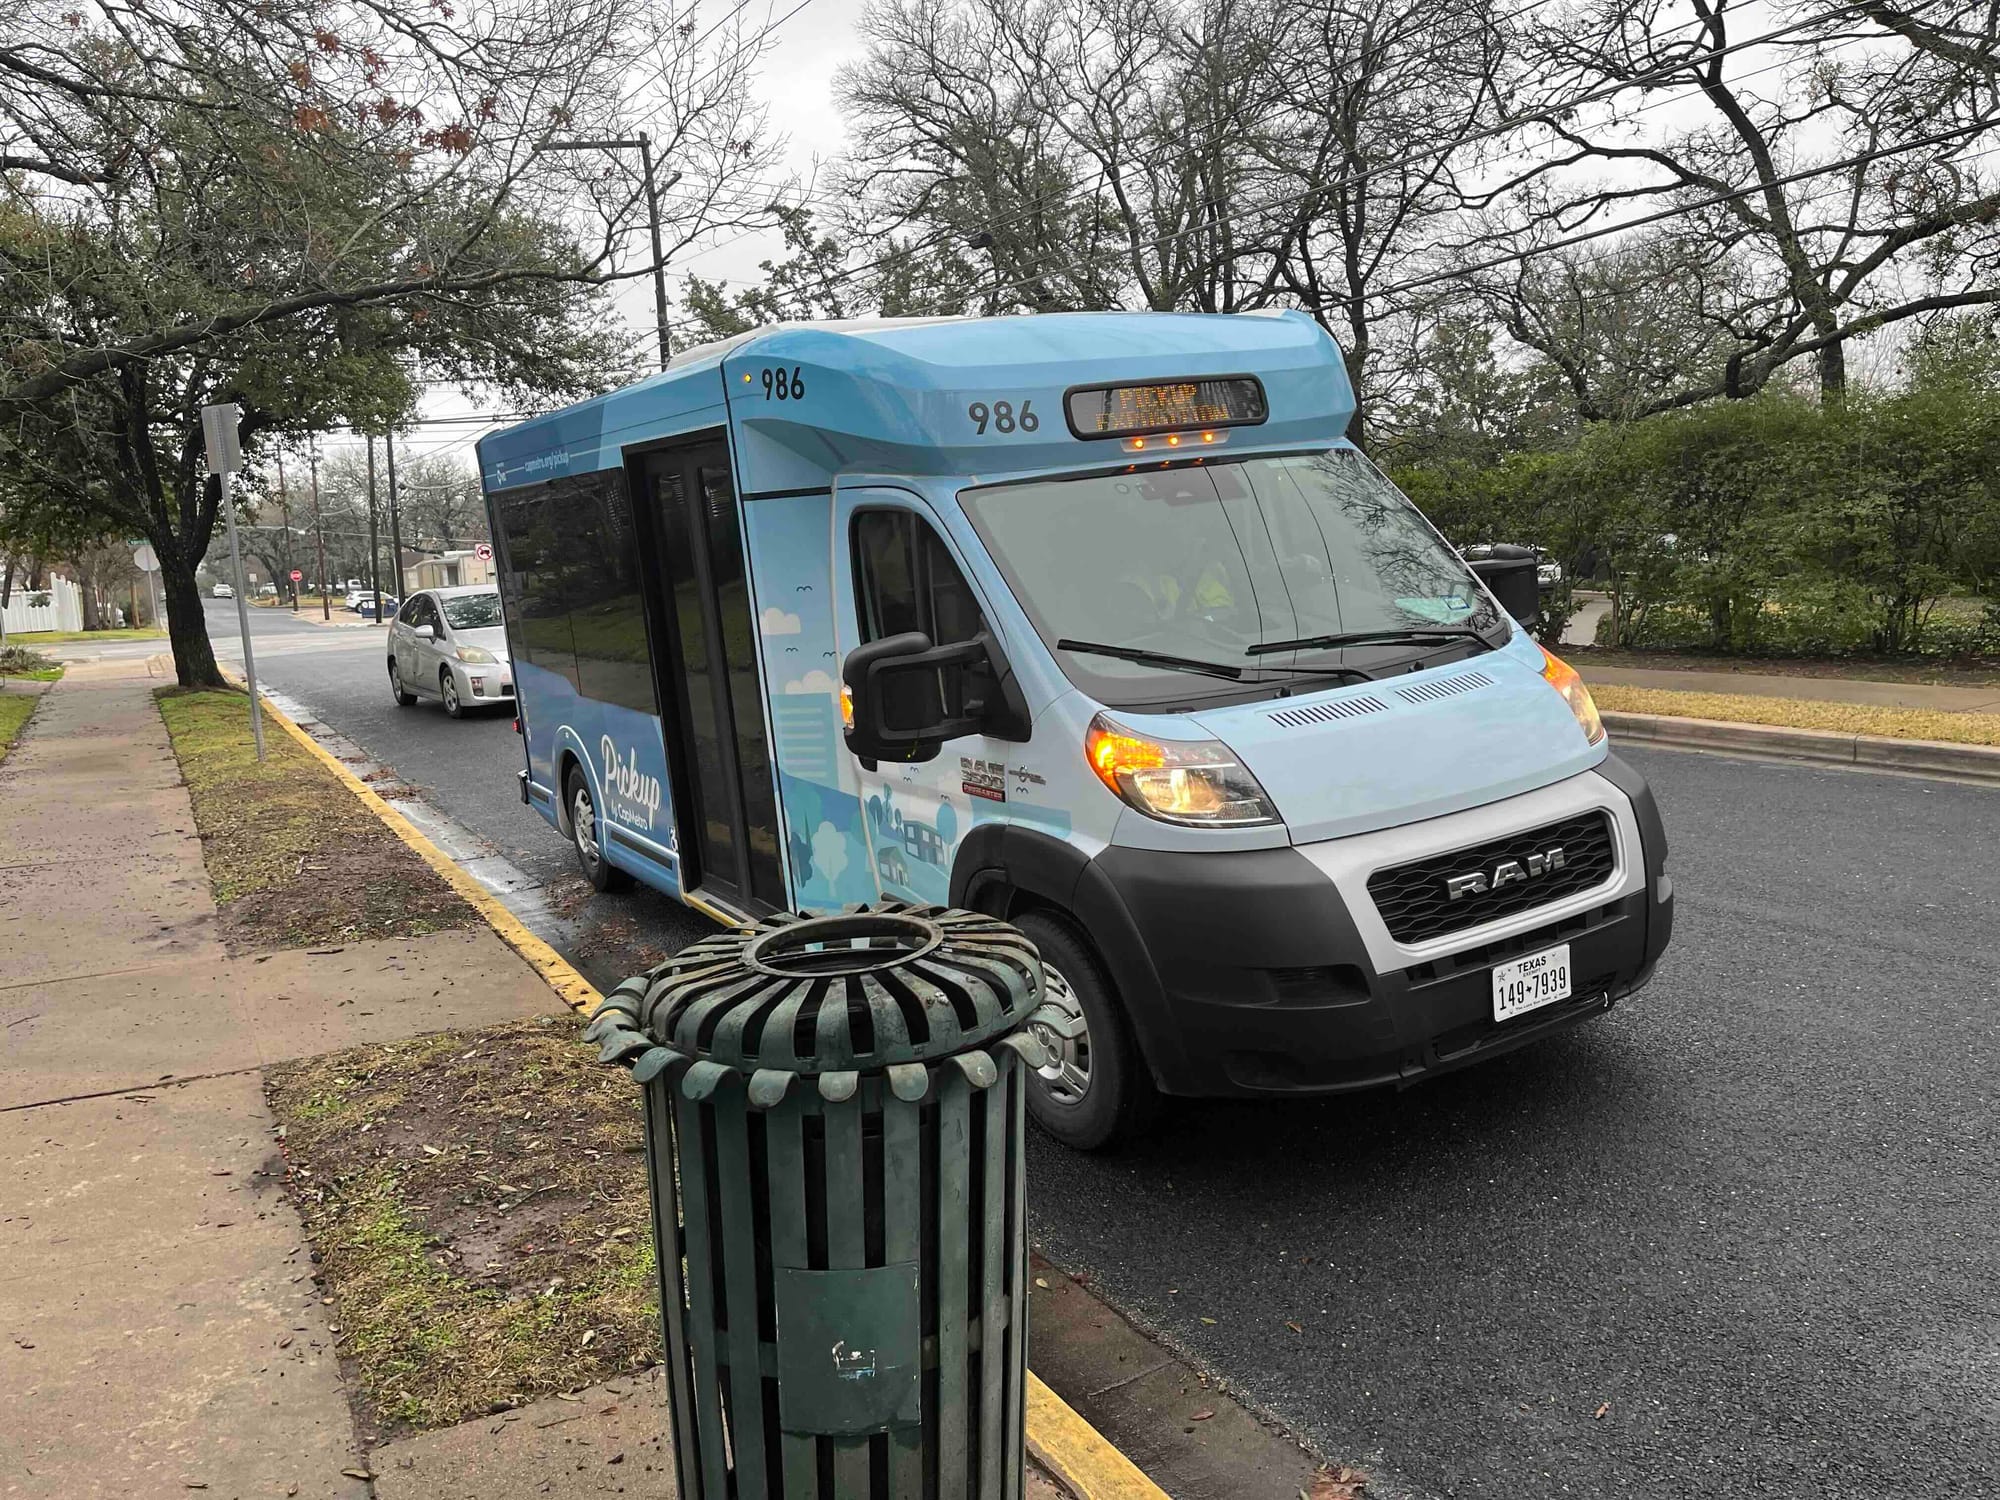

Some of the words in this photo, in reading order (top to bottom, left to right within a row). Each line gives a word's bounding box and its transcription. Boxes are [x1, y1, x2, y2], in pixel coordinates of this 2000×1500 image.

[761, 367, 805, 401] 986
[968, 400, 1040, 435] 986
[601, 733, 660, 832] Pickup
[1447, 848, 1566, 901] RAM
[1517, 955, 1547, 974] TEXAS
